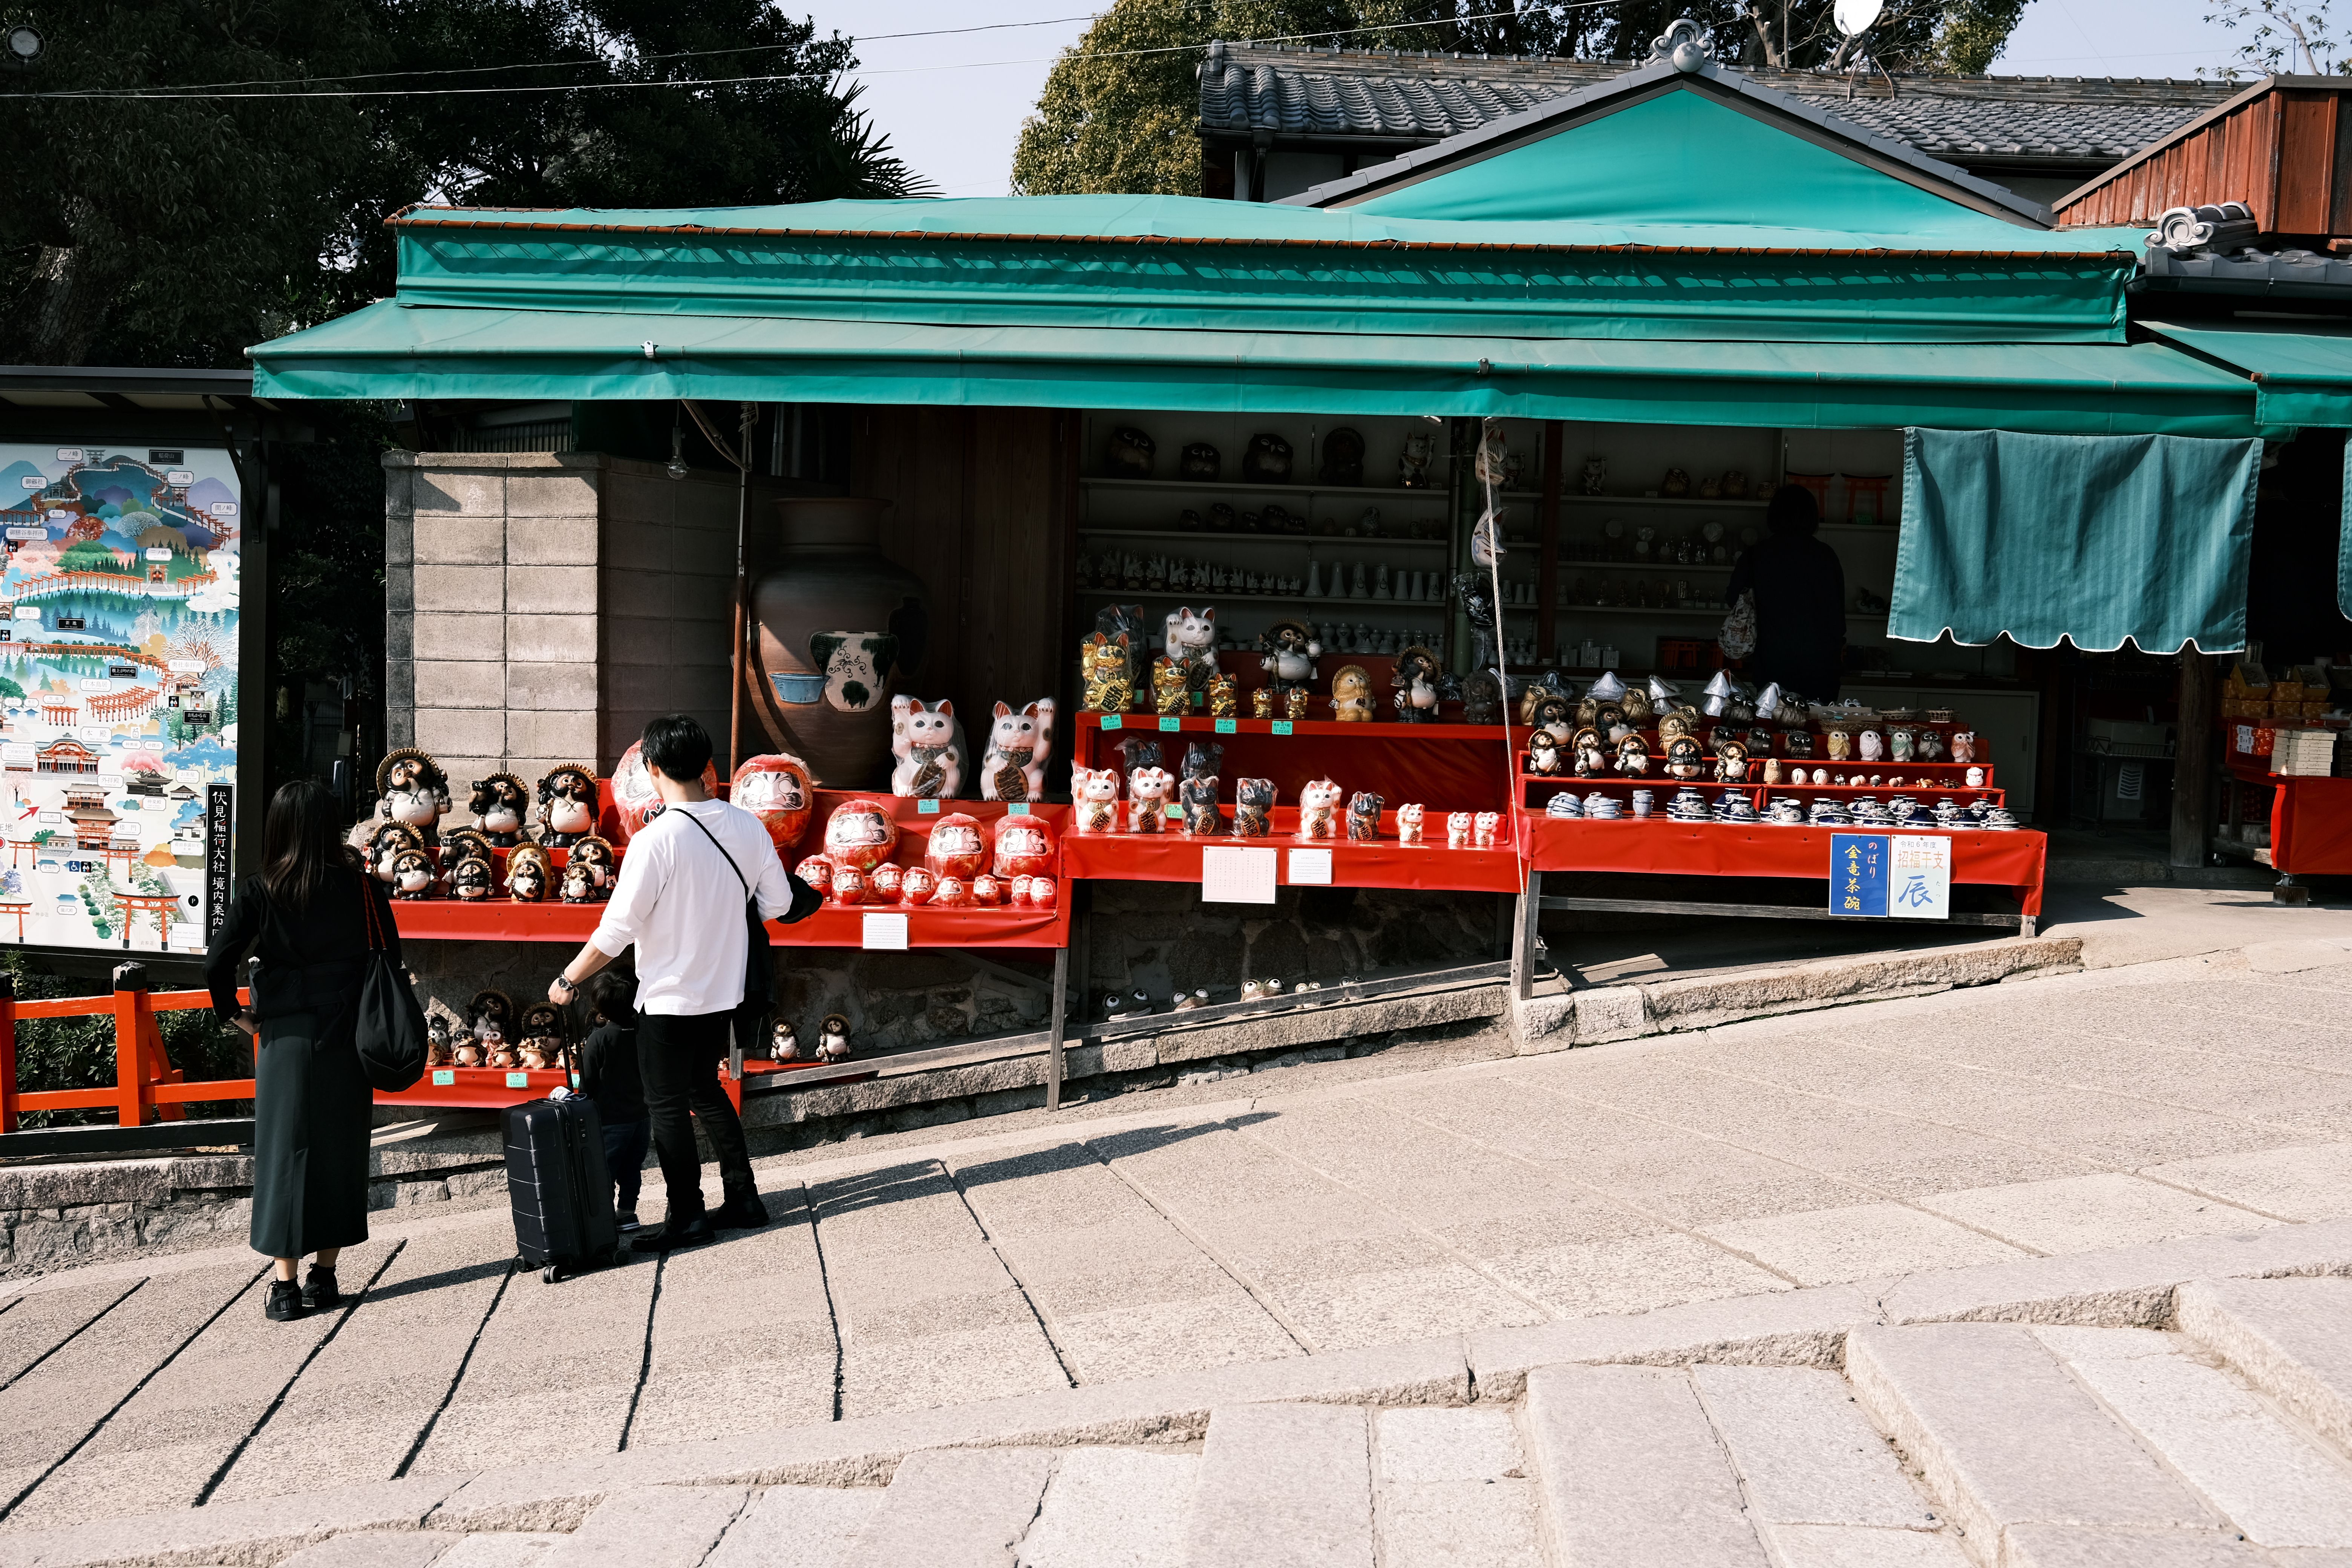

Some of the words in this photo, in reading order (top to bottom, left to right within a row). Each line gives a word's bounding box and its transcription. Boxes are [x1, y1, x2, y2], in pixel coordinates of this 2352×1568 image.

[172, 661, 203, 669] 奥社奉拝所
[85, 729, 107, 738] 本殿
[212, 791, 227, 873] 伏見稲荷大社
[1867, 842, 1879, 879] のぼり
[1898, 850, 1944, 869] 招福干支
[1844, 844, 1862, 910] 金竜茶碗
[1898, 875, 1933, 908] 辰
